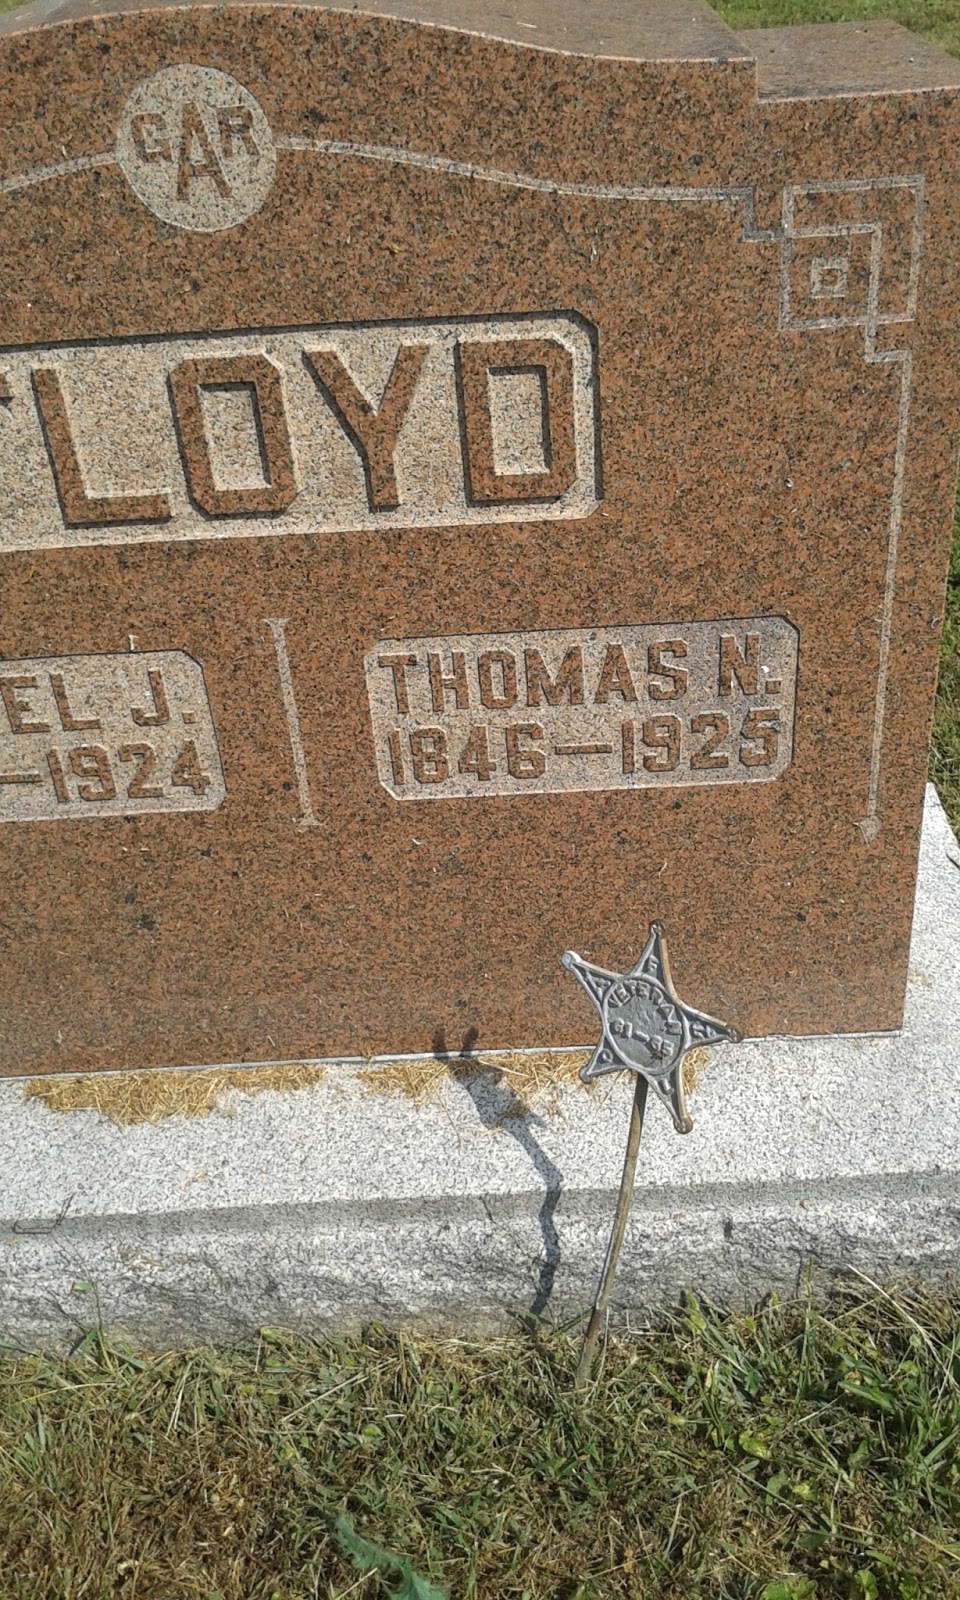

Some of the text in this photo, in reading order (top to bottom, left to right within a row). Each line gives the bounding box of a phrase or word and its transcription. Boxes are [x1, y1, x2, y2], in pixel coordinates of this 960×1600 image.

[0, 338, 577, 528] LOYD
[131, 668, 197, 727] J.
[378, 633, 782, 714] THOMAS N.
